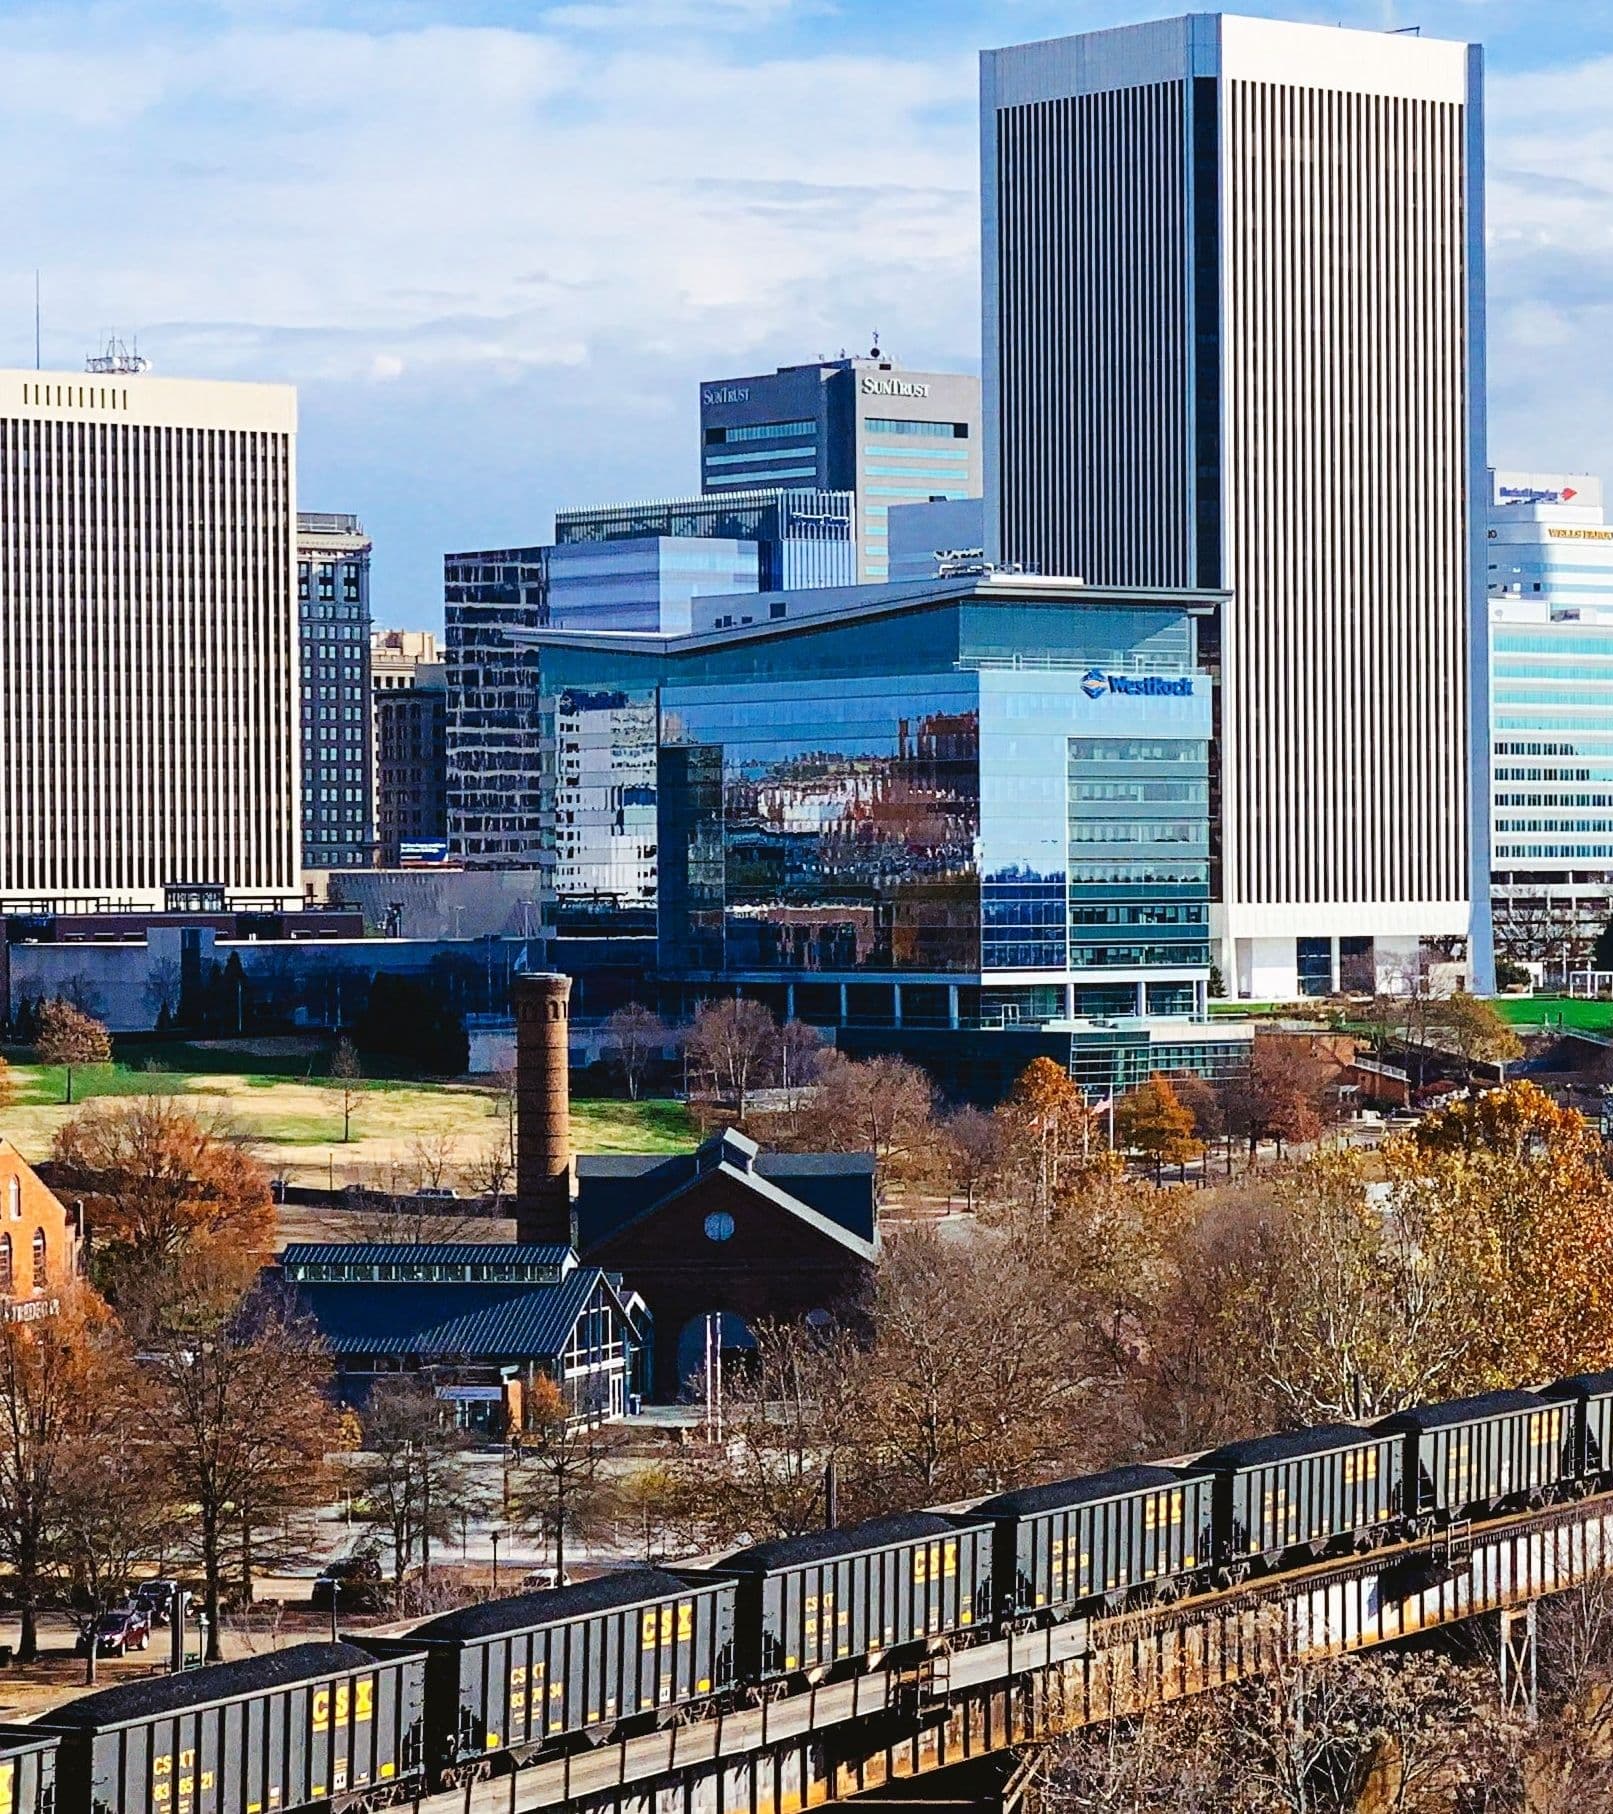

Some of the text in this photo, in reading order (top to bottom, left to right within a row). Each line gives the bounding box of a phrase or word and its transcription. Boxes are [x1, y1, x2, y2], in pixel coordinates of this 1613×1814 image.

[1107, 675, 1194, 696] WestRock
[914, 1543, 957, 1576] CSX
[642, 1604, 693, 1642] CSX
[312, 1680, 373, 1723] CSX
